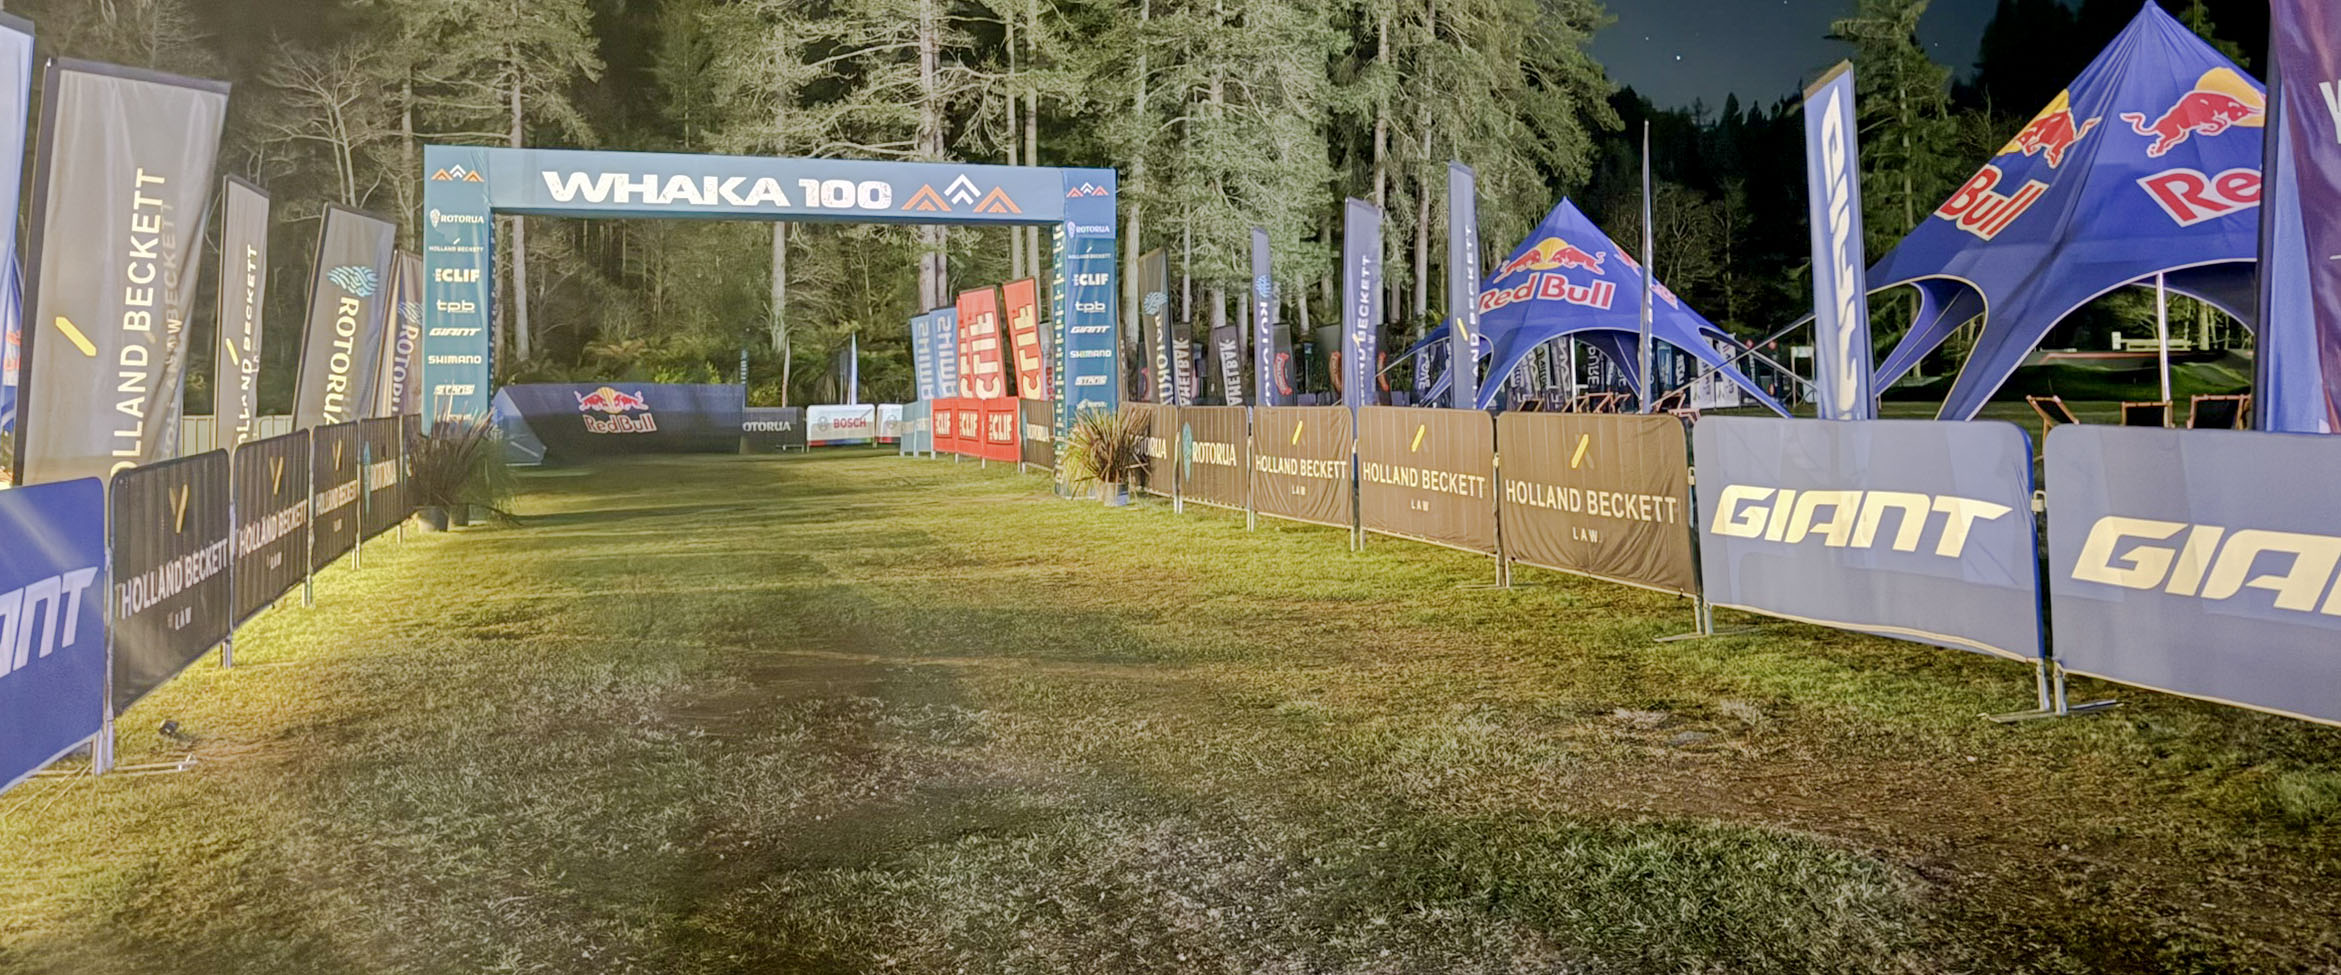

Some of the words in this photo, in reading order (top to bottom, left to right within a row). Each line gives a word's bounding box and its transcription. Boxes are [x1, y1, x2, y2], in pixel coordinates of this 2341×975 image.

[542, 171, 791, 206] WHAKA
[798, 179, 893, 209] 100
[1936, 166, 2046, 239] Bull
[441, 215, 484, 224] ROTORUA
[1076, 225, 1110, 233] ROTORUA
[124, 168, 165, 331] BECKETT
[442, 268, 480, 282] CLIF
[1079, 273, 1109, 287] CLIF
[242, 245, 257, 351] BECKETT
[1357, 255, 1370, 341] BECKETT
[1480, 273, 1539, 313] Red
[1538, 274, 1615, 309] Bull
[436, 299, 475, 313] tpb
[1075, 301, 1105, 313] tpb
[429, 328, 481, 336] GIANT
[1070, 326, 1110, 334] GIANT
[428, 355, 481, 364] SHIMANO
[584, 414, 618, 433] Red
[619, 413, 657, 432] Bull
[834, 417, 867, 429] BOSCH
[938, 412, 950, 435] CLIF
[961, 413, 978, 437] CLIF
[992, 414, 1012, 441] CLIF
[1130, 436, 1167, 460] OTORUA
[1193, 442, 1237, 467] ROTORUA
[1256, 454, 1297, 476] HOLLAND
[1300, 458, 1347, 480] BECKETT
[1363, 462, 1418, 487] HOLLAND
[1422, 470, 1485, 499] BECKETT
[1411, 499, 1429, 512] LAW
[1506, 480, 1581, 513] HOLLAND
[1587, 490, 1677, 524] BECKETT
[238, 516, 277, 559] HOLLAND
[278, 499, 307, 538] BECKETT
[1710, 485, 2013, 558] GIANT
[1573, 527, 1598, 543] LAW
[2071, 515, 2341, 617] GIA
[120, 559, 183, 620] HOLLAND
[185, 538, 228, 588] BECKETT
[175, 606, 192, 631] LAW
